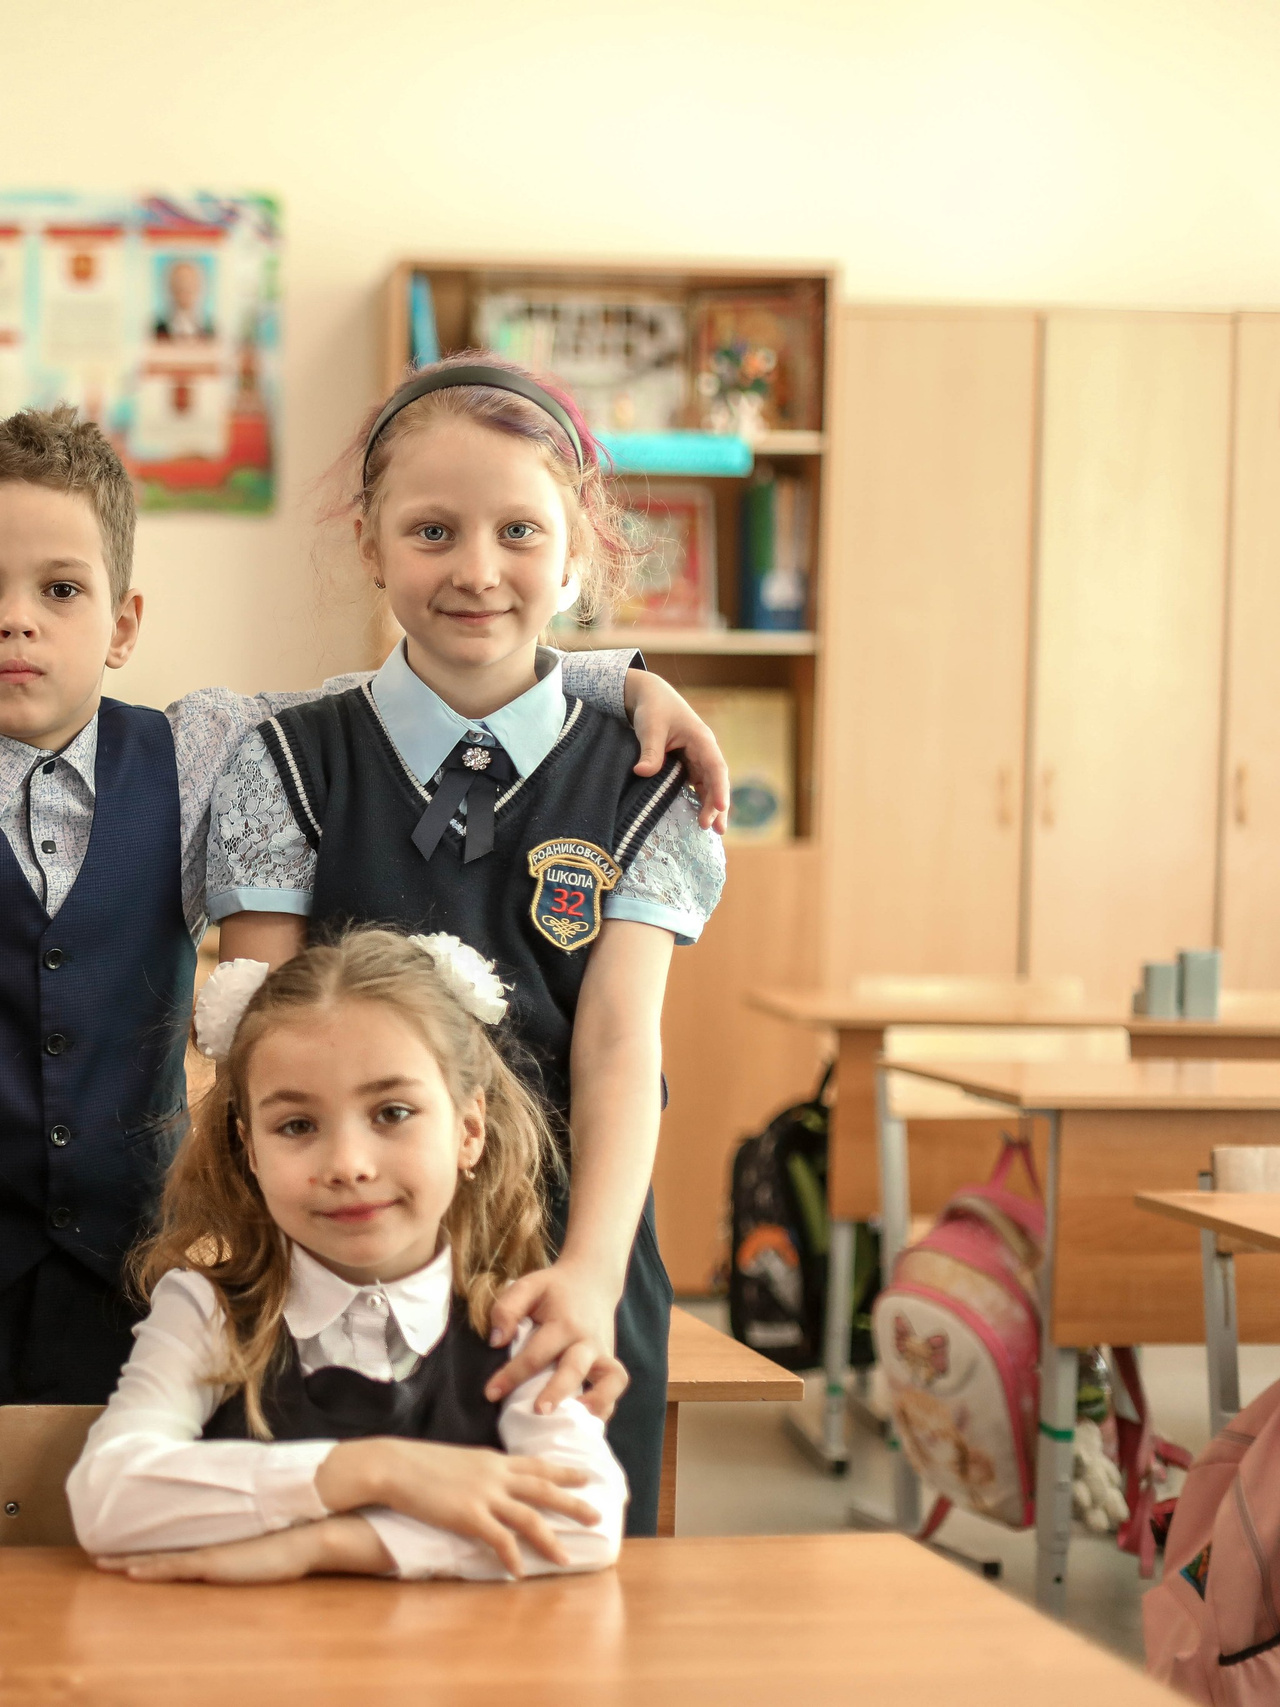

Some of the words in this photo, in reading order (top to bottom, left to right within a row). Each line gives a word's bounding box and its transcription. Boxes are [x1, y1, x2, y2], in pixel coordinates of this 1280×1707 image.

[532, 843, 616, 878] РОДНИКОВСКАЯ
[547, 869, 593, 889] ШКОЛА
[551, 888, 585, 917] 32
